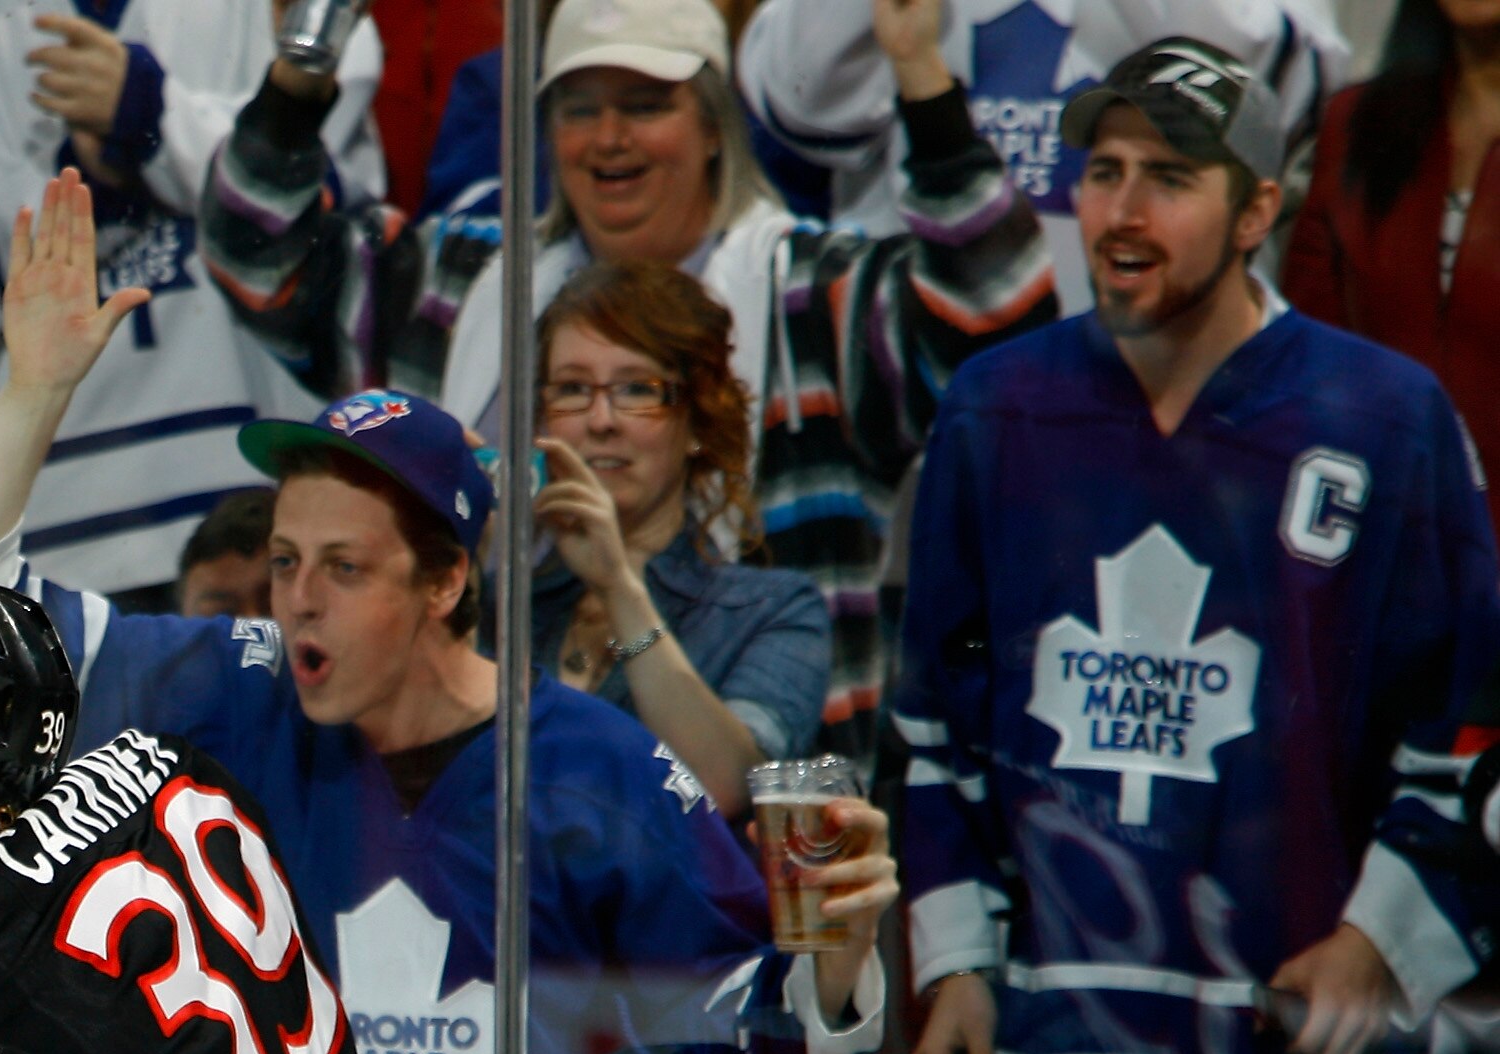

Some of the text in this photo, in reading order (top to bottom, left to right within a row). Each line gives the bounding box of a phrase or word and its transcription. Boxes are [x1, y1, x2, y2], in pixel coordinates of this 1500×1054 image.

[1277, 446, 1372, 567] C
[1060, 650, 1230, 695] TORONTO
[1082, 684, 1197, 724] MAPLE
[34, 711, 66, 754] 39
[1089, 719, 1188, 758] LEAFS
[350, 1012, 480, 1050] RONTO
